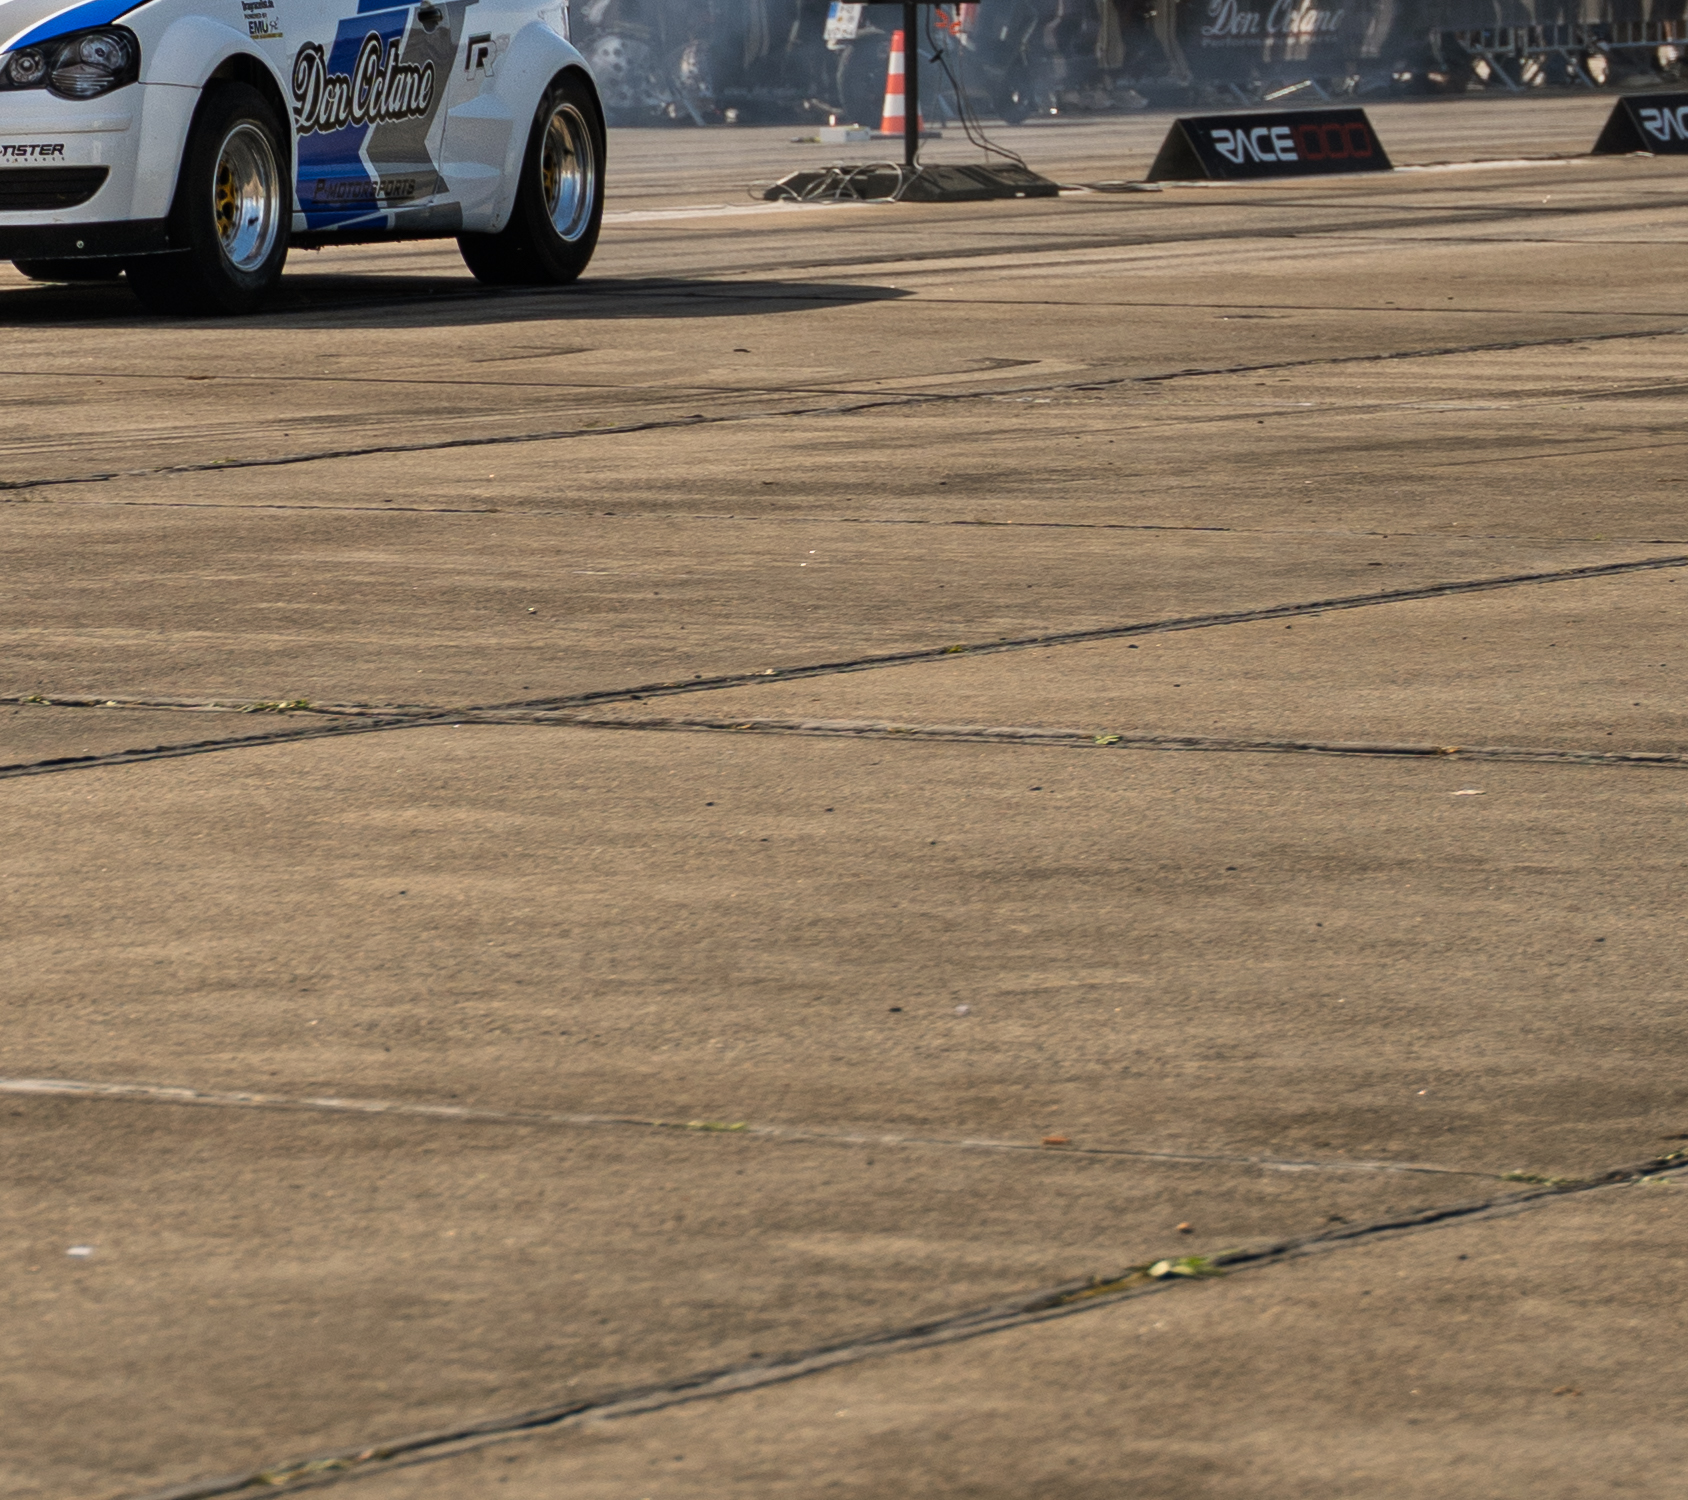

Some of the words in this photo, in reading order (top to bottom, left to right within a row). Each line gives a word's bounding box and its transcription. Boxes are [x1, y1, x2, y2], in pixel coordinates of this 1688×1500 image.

[248, 20, 269, 34] EMU
[291, 41, 350, 136] Don
[348, 30, 435, 127] Octane
[1211, 123, 1373, 164] RACE1000
